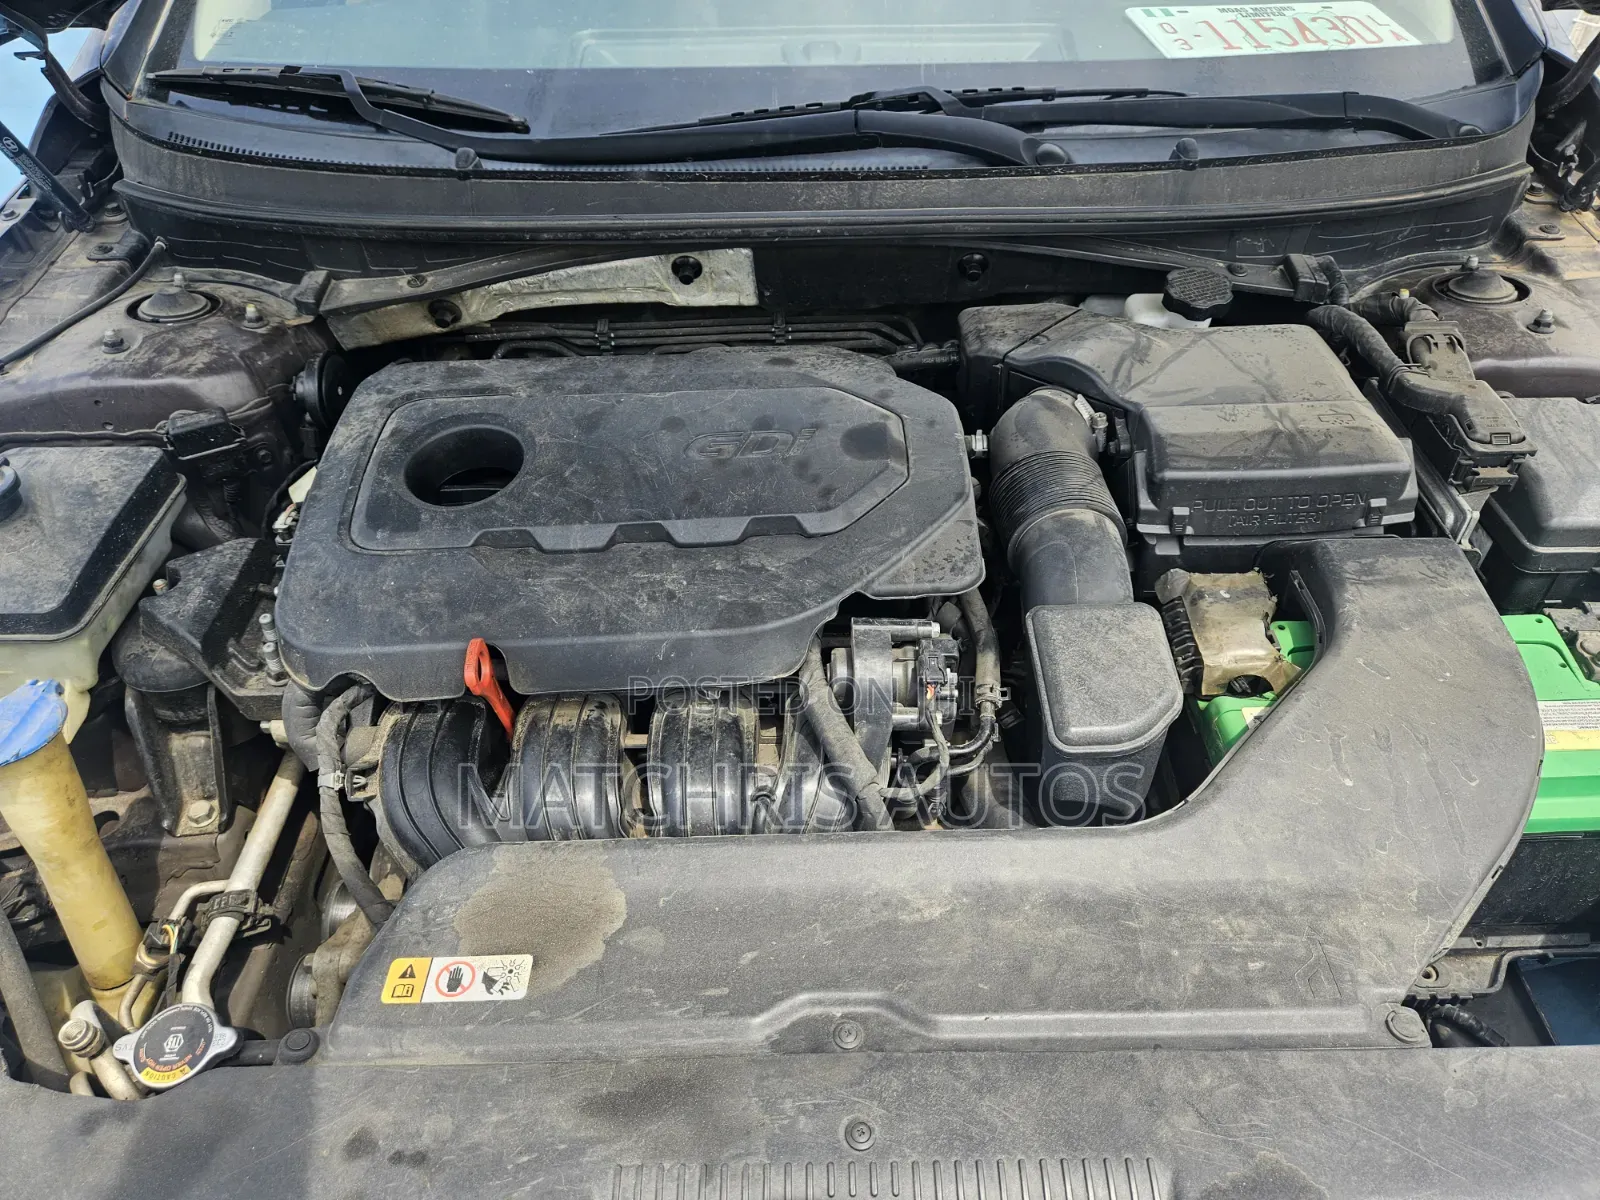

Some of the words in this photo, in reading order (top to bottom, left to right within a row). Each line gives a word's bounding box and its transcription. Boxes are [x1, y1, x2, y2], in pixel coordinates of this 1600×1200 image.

[1190, 500, 1239, 513] PULL
[1243, 497, 1283, 512] OUT
[1286, 496, 1311, 510] TO
[1315, 493, 1368, 509] OPEN
[114, 1042, 134, 1051] TVS
[158, 1063, 173, 1072] OPEN
[143, 1070, 177, 1081] CAUTION
